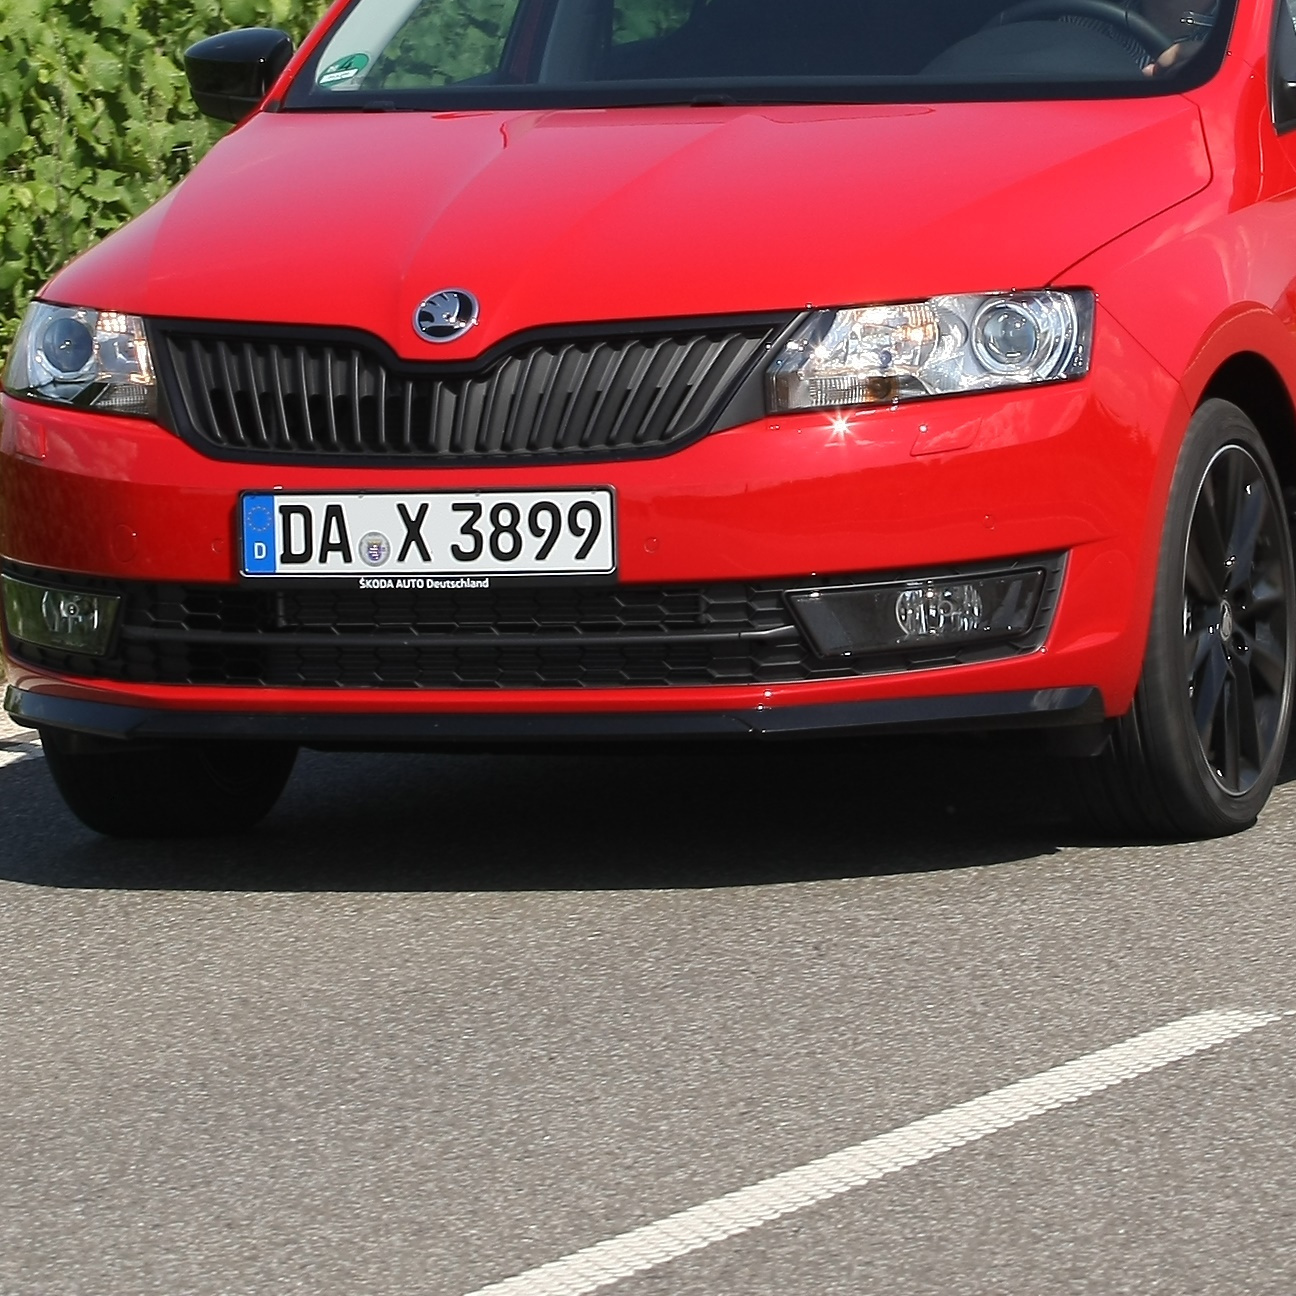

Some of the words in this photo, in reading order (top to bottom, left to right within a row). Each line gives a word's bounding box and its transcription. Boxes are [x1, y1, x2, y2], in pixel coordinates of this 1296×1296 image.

[278, 504, 353, 564] DA
[397, 503, 432, 562] X
[450, 501, 603, 562] 3899
[254, 542, 267, 560] D
[359, 577, 394, 590] ŠKODA
[396, 578, 425, 589] AUTO
[426, 577, 490, 589] Deutschland
